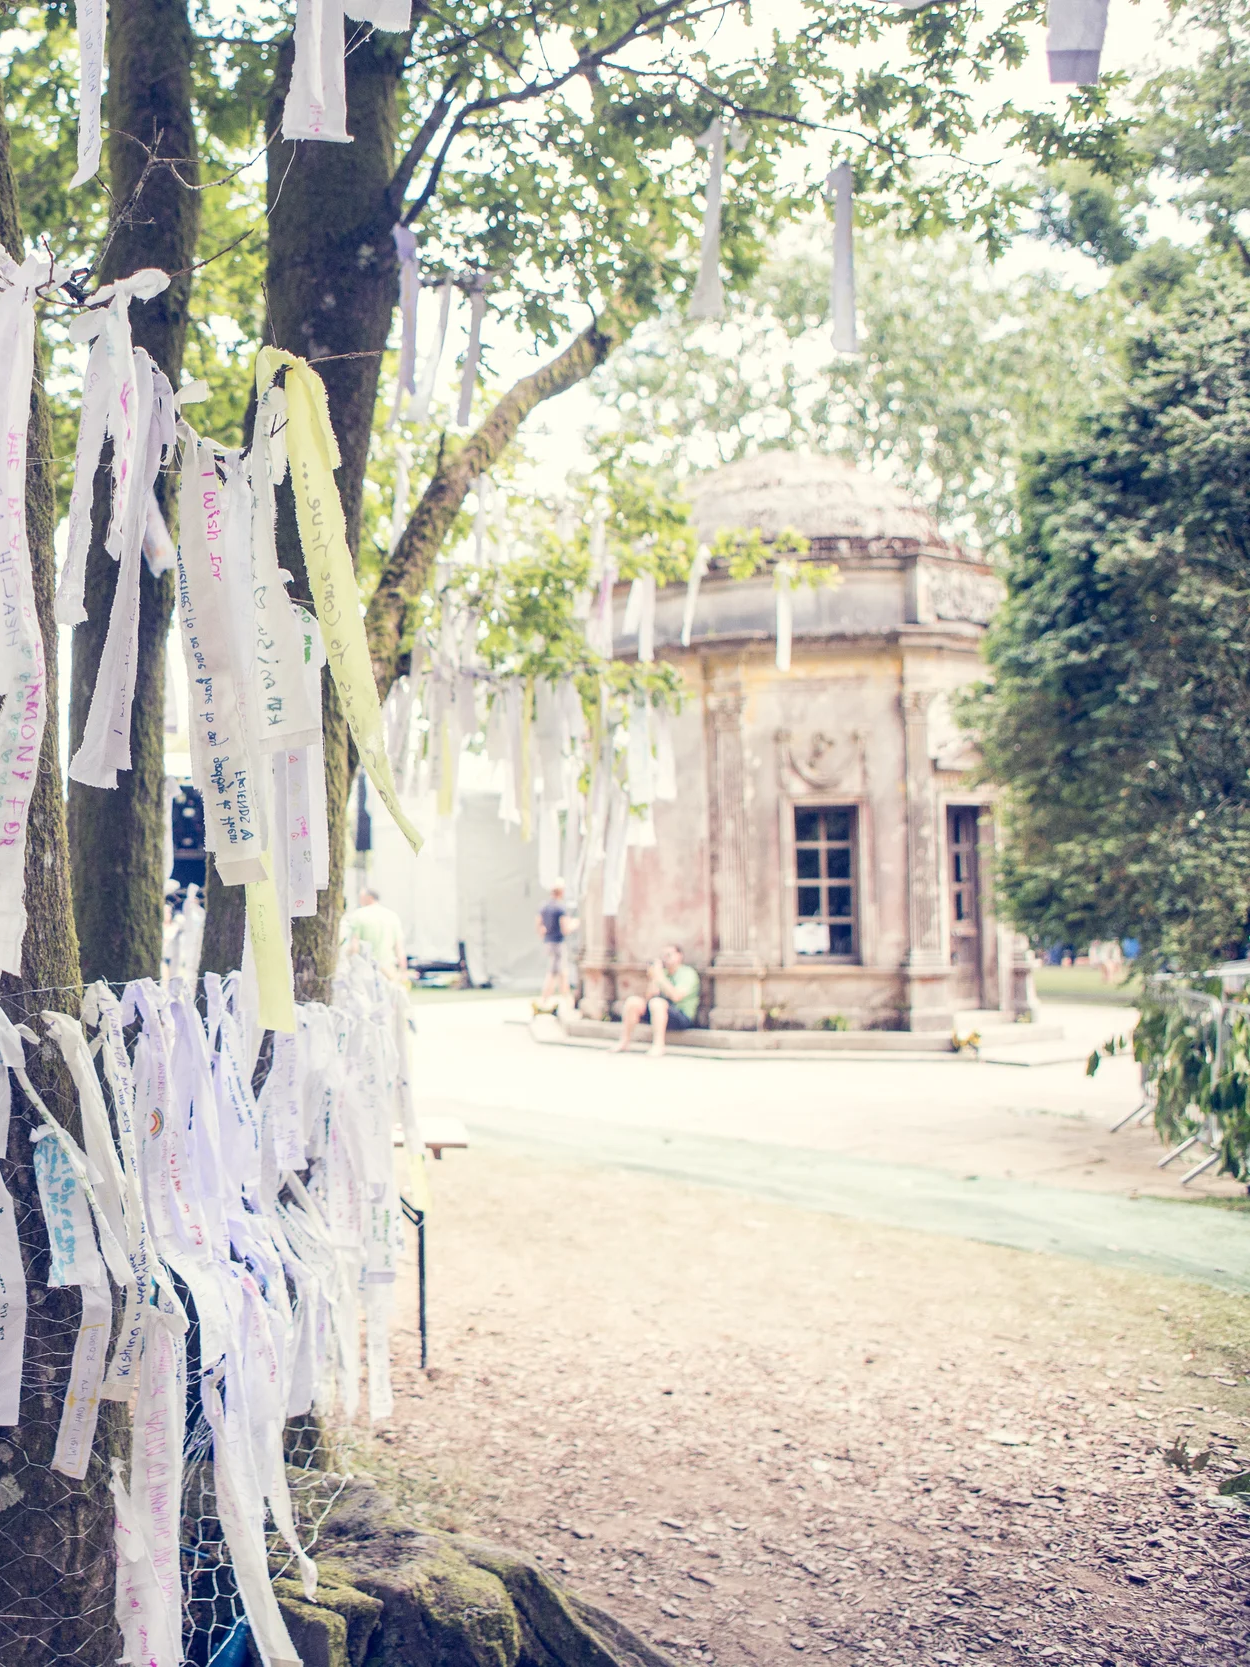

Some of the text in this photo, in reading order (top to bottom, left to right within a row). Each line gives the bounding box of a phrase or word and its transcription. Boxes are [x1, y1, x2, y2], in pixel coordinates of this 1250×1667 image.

[156, 1061, 166, 1103] ANDREW
[80, 1378, 89, 1394] TV
[74, 1405, 87, 1425] HAD
[144, 1407, 168, 1458] NEPAL
[146, 1462, 169, 1484] TO
[149, 1483, 171, 1539] JOURNEY
